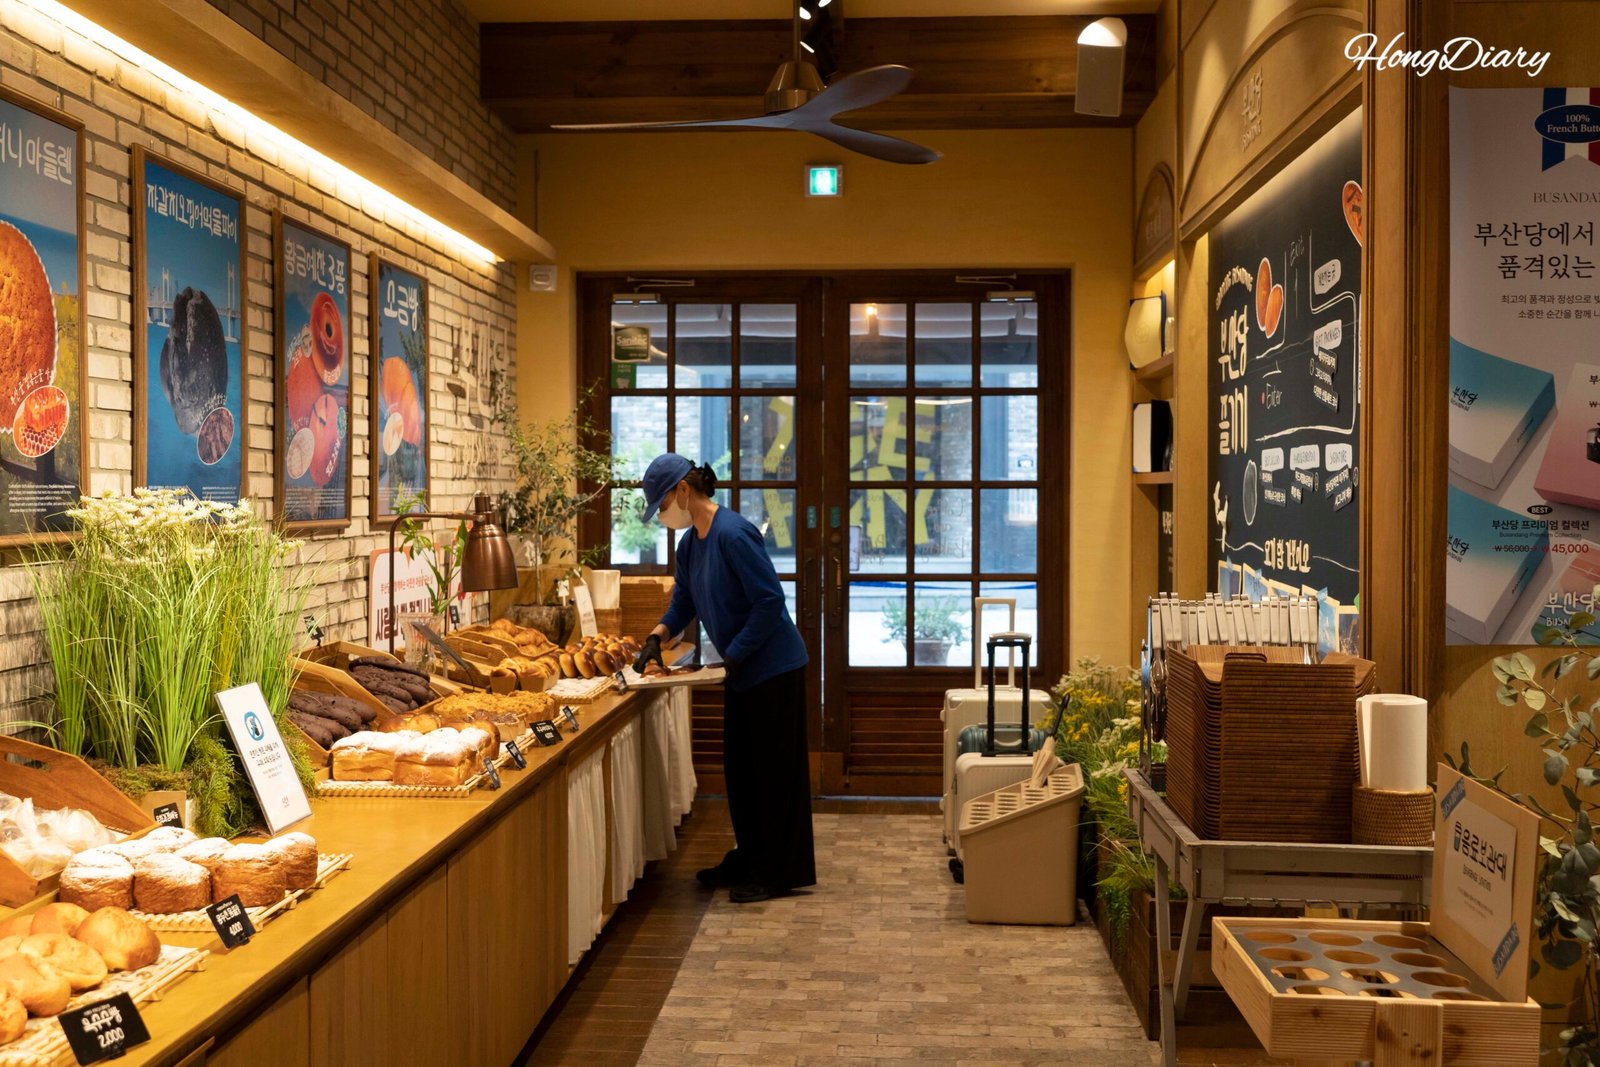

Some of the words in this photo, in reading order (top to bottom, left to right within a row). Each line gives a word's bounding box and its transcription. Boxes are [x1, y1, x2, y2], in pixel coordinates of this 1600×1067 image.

[1565, 114, 1590, 123] 100%
[1547, 124, 1578, 134] French
[1473, 222, 1594, 247] 부산당에서
[1497, 254, 1595, 280] 품격있는
[1501, 295, 1527, 304] 최고의
[1529, 295, 1555, 304] 품격과
[1557, 295, 1591, 304] 정성으로
[1518, 310, 1544, 319] 소중한
[1546, 310, 1571, 319] 순간을
[1574, 310, 1592, 319] 함께
[1219, 305, 1249, 384] 부산당
[1589, 375, 1600, 385] 부
[1452, 386, 1479, 406] 부산당
[1492, 520, 1519, 530] 부산당
[1521, 520, 1558, 530] 프리미엄
[1562, 520, 1590, 530] 컬렉션
[1551, 544, 1589, 555] 45,000
